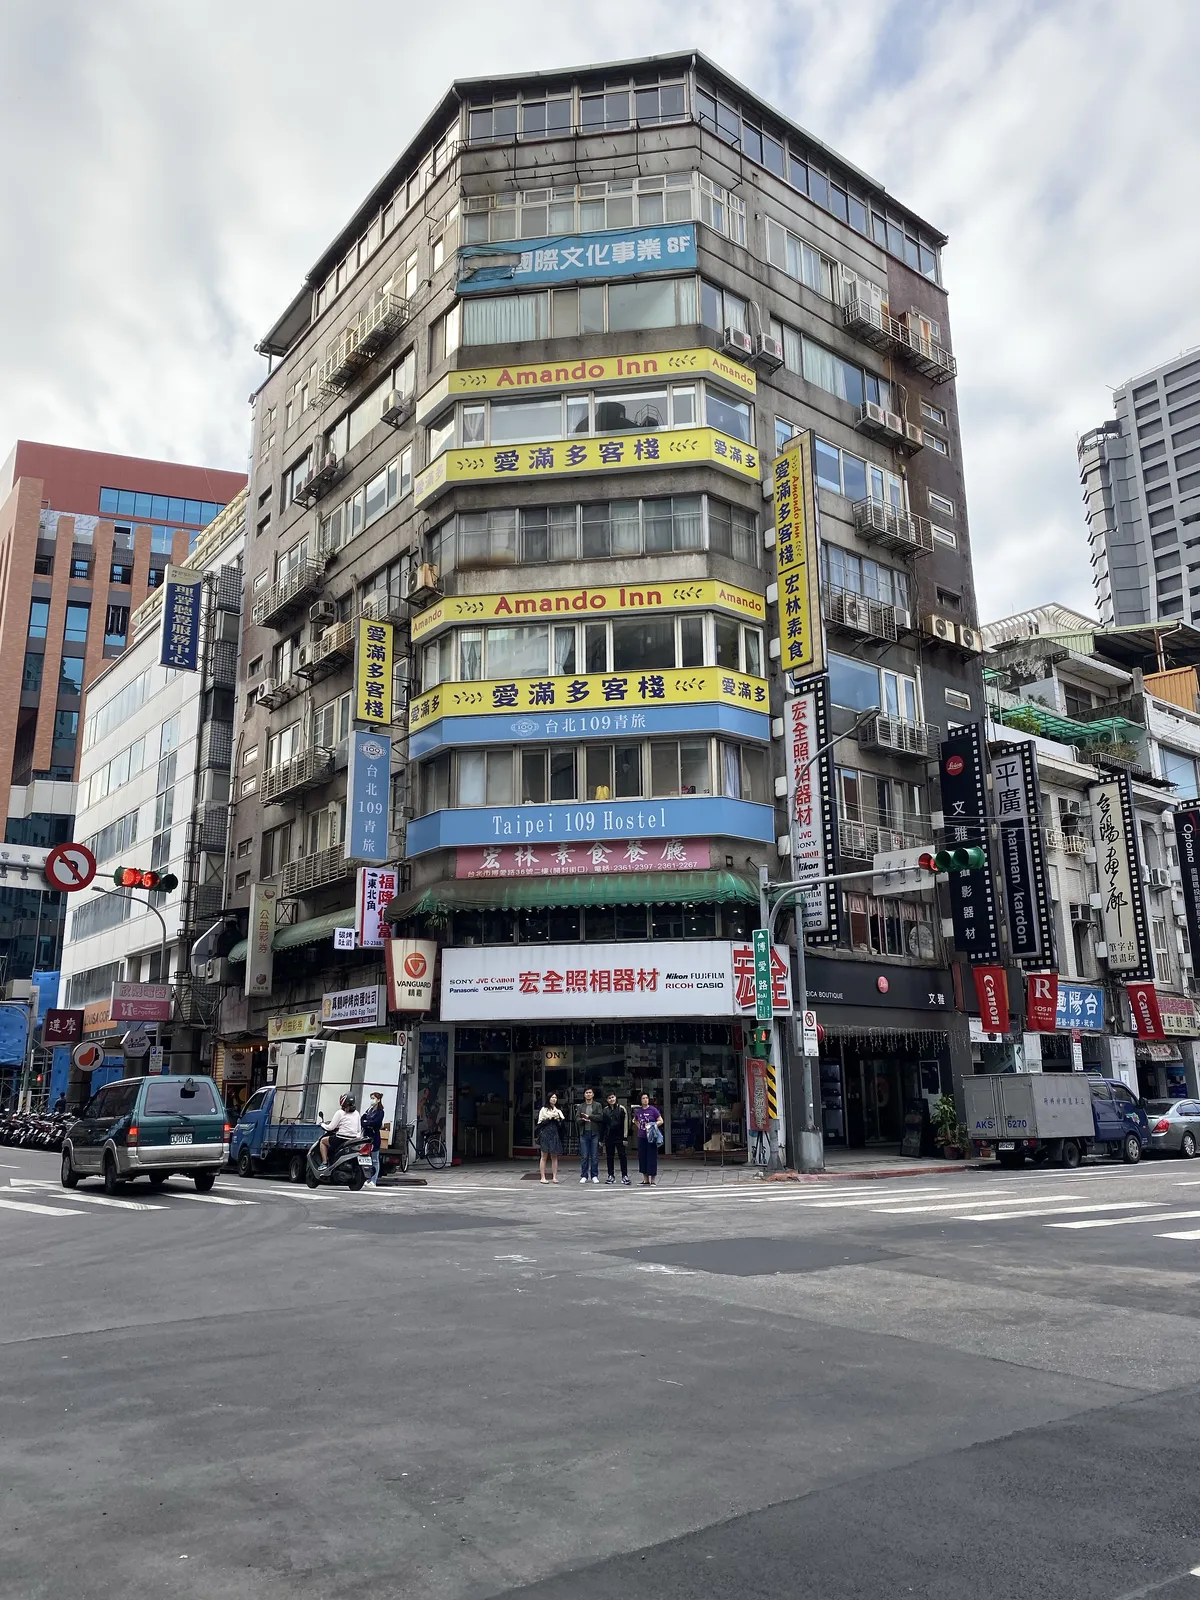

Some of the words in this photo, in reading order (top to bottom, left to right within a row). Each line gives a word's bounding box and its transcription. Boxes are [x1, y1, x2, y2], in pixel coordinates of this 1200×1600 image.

[667, 236, 690, 253] 8F
[497, 361, 604, 387] Amando
[617, 357, 658, 375] Inn
[712, 358, 754, 386] Amando
[493, 438, 661, 471] 愛滿多客棧
[714, 438, 756, 469] 愛滿多
[775, 458, 794, 567] 愛滿多客棧
[791, 475, 800, 520] Amando
[494, 590, 606, 615] Amando
[619, 588, 662, 606] Inn
[719, 589, 762, 613] Amando
[412, 609, 442, 633] Amando
[784, 573, 804, 661] 宏林素食
[364, 625, 386, 719] 愛滿多客棧
[492, 675, 665, 707] 愛滿多客棧
[721, 677, 765, 702] 愛滿多
[410, 694, 440, 724] 愛滿多
[545, 714, 646, 734] 台北109青旅
[995, 761, 1021, 815] 平廣
[493, 813, 553, 838] Taipei
[565, 812, 595, 832] 109
[604, 808, 666, 829] Hostel
[481, 839, 688, 869] 宏林素食餐廳
[800, 850, 819, 858] anon
[1183, 823, 1194, 863] Optoma
[367, 879, 377, 911] 東北角
[1007, 829, 1027, 945] harman/kardon
[518, 967, 660, 995] 宏全照相器材
[757, 942, 768, 990] 博愛路
[396, 980, 431, 988] VANGUARD
[928, 993, 945, 1005] 文雅
[1034, 978, 1053, 999] R
[983, 974, 999, 1025] Canon
[1137, 991, 1155, 1033] Canon
[546, 1051, 568, 1059] ONY
[1008, 1120, 1027, 1128] 6270
